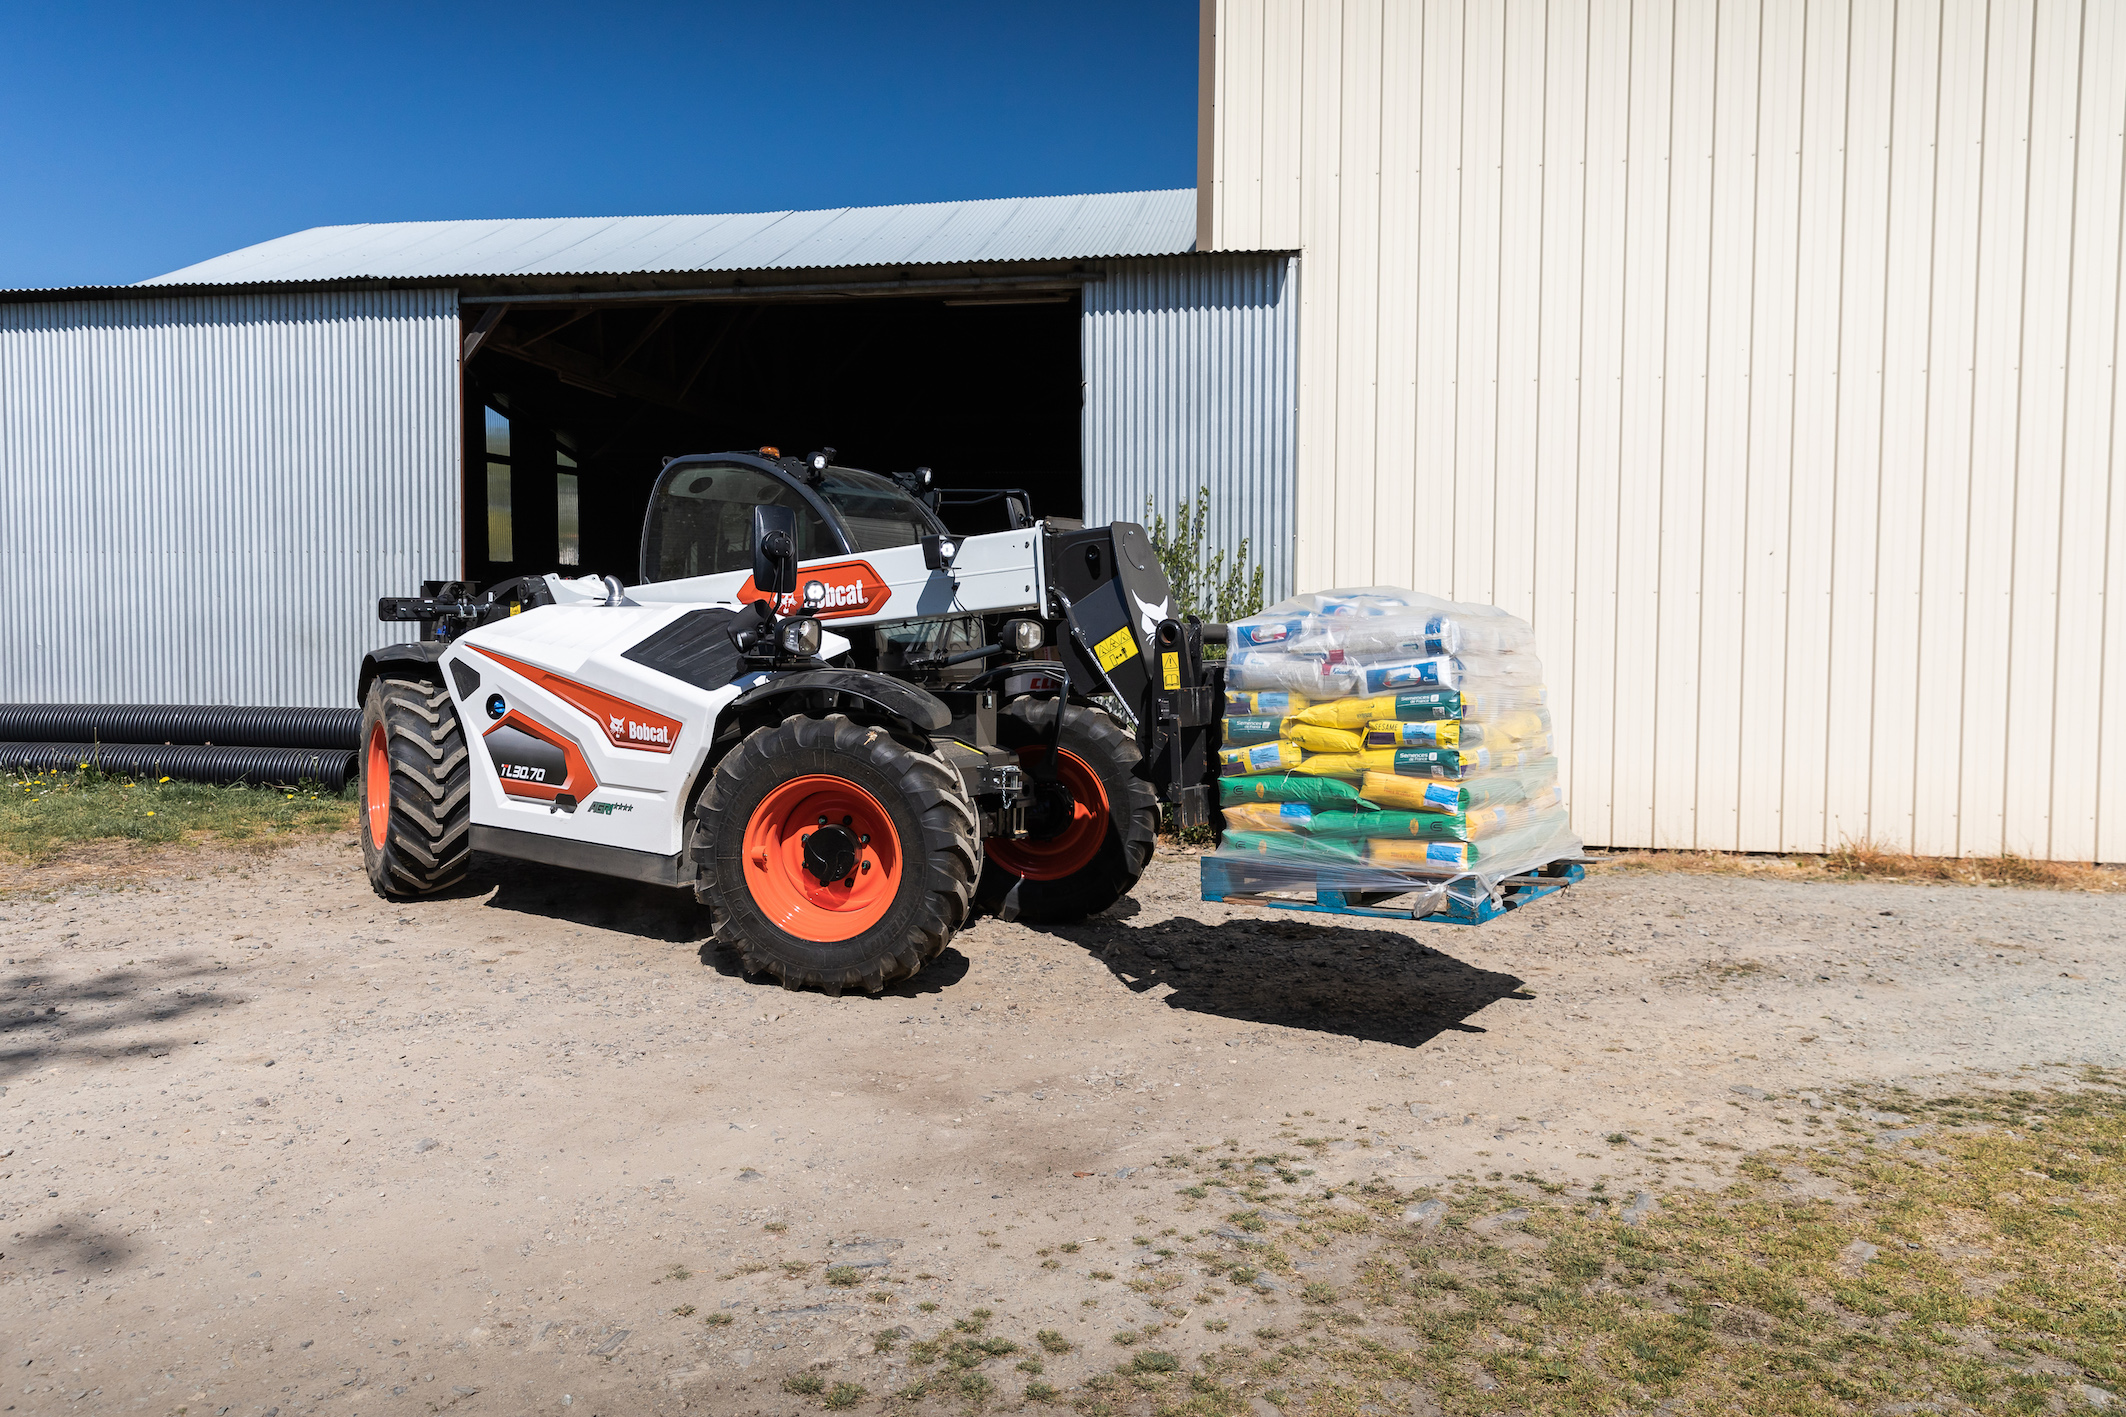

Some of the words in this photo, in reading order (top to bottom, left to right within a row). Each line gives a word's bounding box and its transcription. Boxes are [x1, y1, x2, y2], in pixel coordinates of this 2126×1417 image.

[803, 579, 865, 609] bcat
[628, 720, 669, 744] Bobcat
[501, 763, 546, 782] TL30.70
